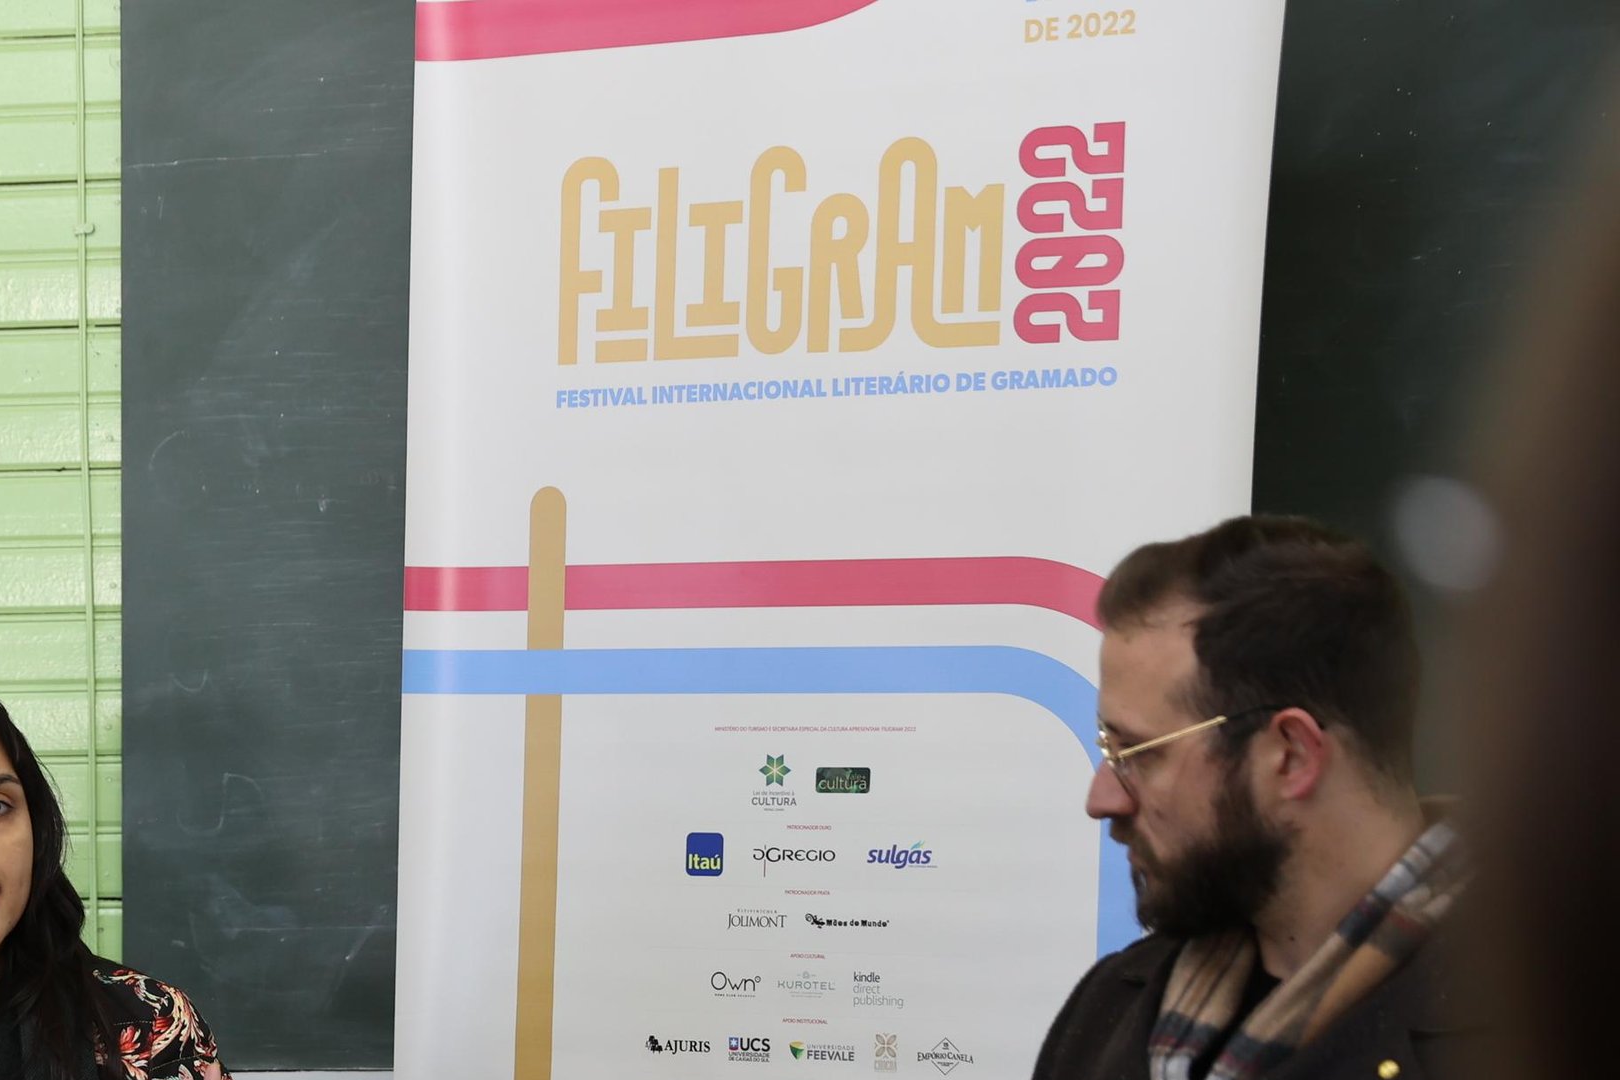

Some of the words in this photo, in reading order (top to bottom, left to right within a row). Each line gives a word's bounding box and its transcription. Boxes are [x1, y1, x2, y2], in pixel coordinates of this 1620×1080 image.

[1024, 16, 1060, 43] DE
[1067, 9, 1136, 39] 2022
[1013, 121, 1127, 345] 2022
[557, 136, 1005, 366] FILIGRAM
[555, 386, 648, 409] FESTIVAL
[651, 378, 828, 405] INTERNACIONAL
[832, 370, 951, 397] LITERÁRIO
[955, 372, 986, 392] DE
[990, 366, 1119, 391] GRAMADO
[818, 775, 867, 790] cultura
[751, 796, 797, 806] CULTURA
[688, 853, 721, 870] Itaú
[777, 979, 835, 991] KUROTEL
[853, 971, 881, 984] kindle
[853, 983, 881, 995] direct
[853, 995, 905, 1010] publishing
[664, 1039, 711, 1055] AJURIS
[739, 1037, 771, 1052] UCS
[806, 1043, 855, 1051] UNIVERSIDADE
[806, 1050, 855, 1062] FEEVALE
[917, 1050, 947, 1062] EMPÓRIO
[947, 1051, 975, 1064] CANELA
